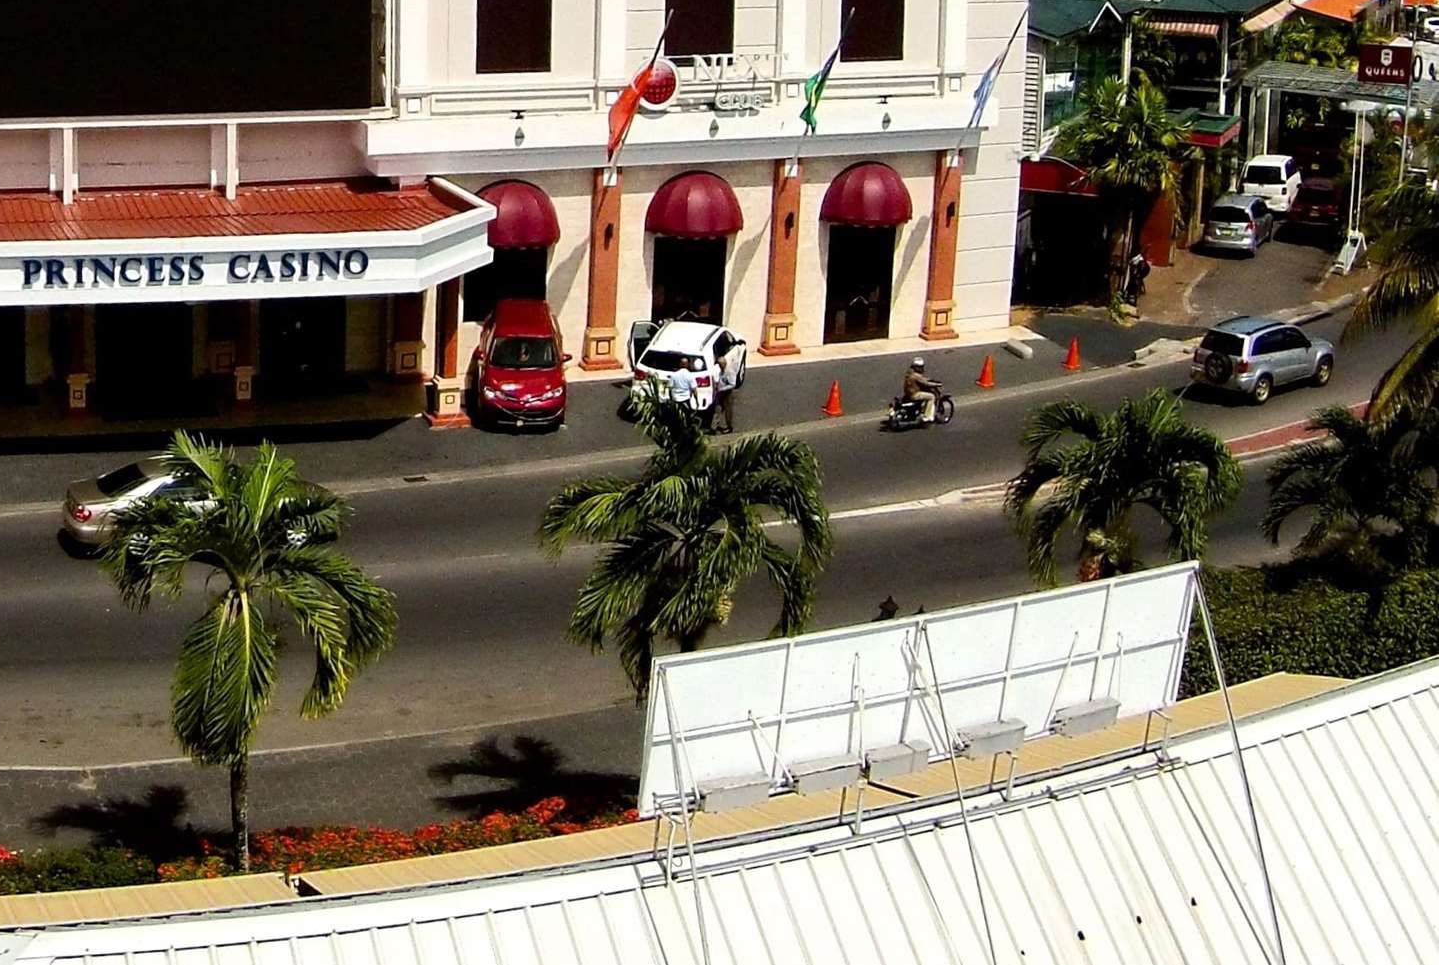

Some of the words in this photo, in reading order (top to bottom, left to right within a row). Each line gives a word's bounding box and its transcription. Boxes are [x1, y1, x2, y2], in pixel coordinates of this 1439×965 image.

[1365, 66, 1405, 77] QUEENS
[22, 254, 206, 287] PRINCESS
[227, 248, 370, 282] CASINO
